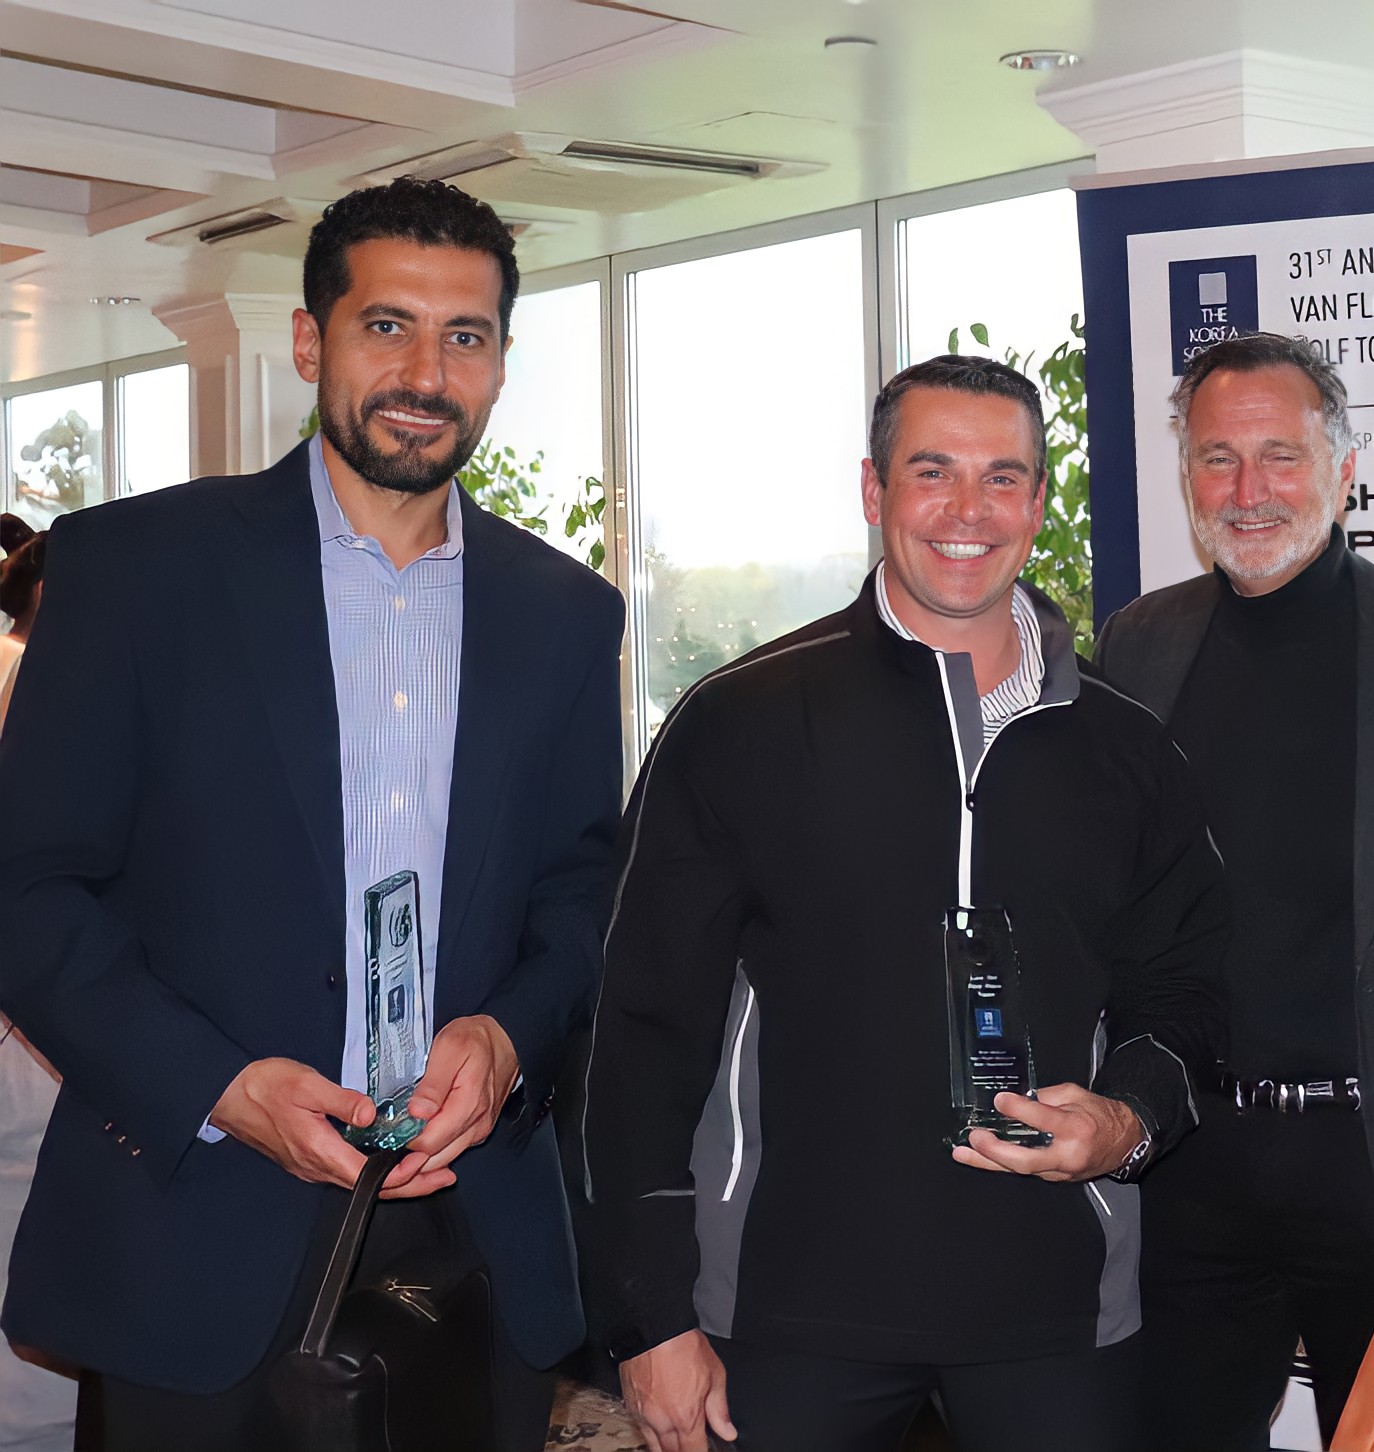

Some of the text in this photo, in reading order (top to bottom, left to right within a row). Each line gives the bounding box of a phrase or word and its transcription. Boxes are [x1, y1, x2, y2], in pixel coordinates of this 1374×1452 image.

[1289, 248, 1332, 279] 31ST
[1200, 306, 1228, 324] THE
[1290, 294, 1338, 323] VAN
[1189, 325, 1239, 343] KOREA
[1294, 335, 1349, 364] OLF
